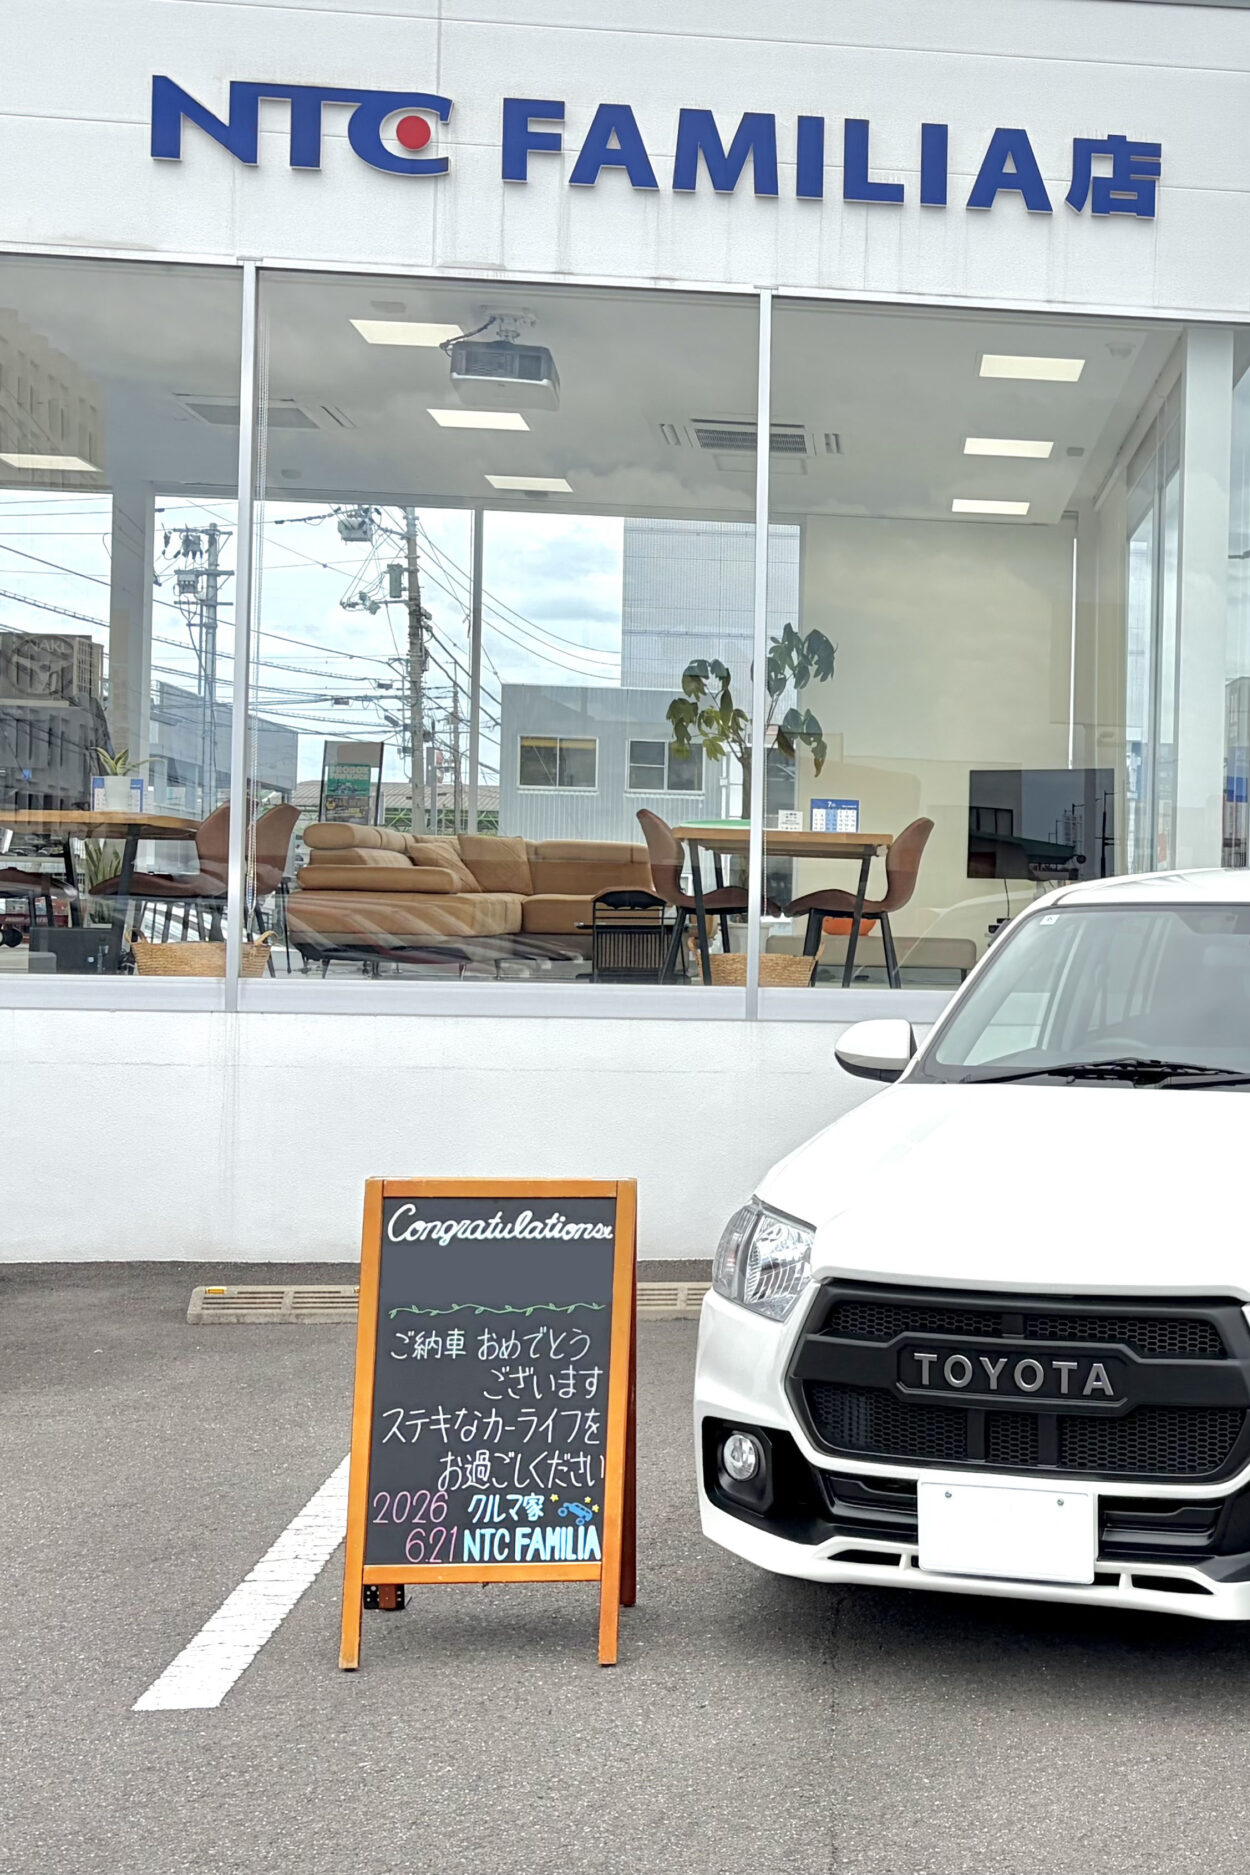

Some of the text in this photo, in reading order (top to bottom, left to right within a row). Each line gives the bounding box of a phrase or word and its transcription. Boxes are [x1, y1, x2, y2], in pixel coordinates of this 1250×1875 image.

[151, 74, 1163, 219] NTC FAMILIA店
[390, 1326, 591, 1361] ご納車 おめでとう
[483, 1364, 603, 1400] ございます
[913, 1352, 1115, 1393] TOYOTA
[382, 1405, 601, 1444] ステキなカーライフを
[437, 1449, 605, 1492] お過ごしください
[373, 1490, 449, 1524] 2026
[467, 1492, 545, 1522] クルマ家
[463, 1525, 602, 1562] NTC FAMILIA
